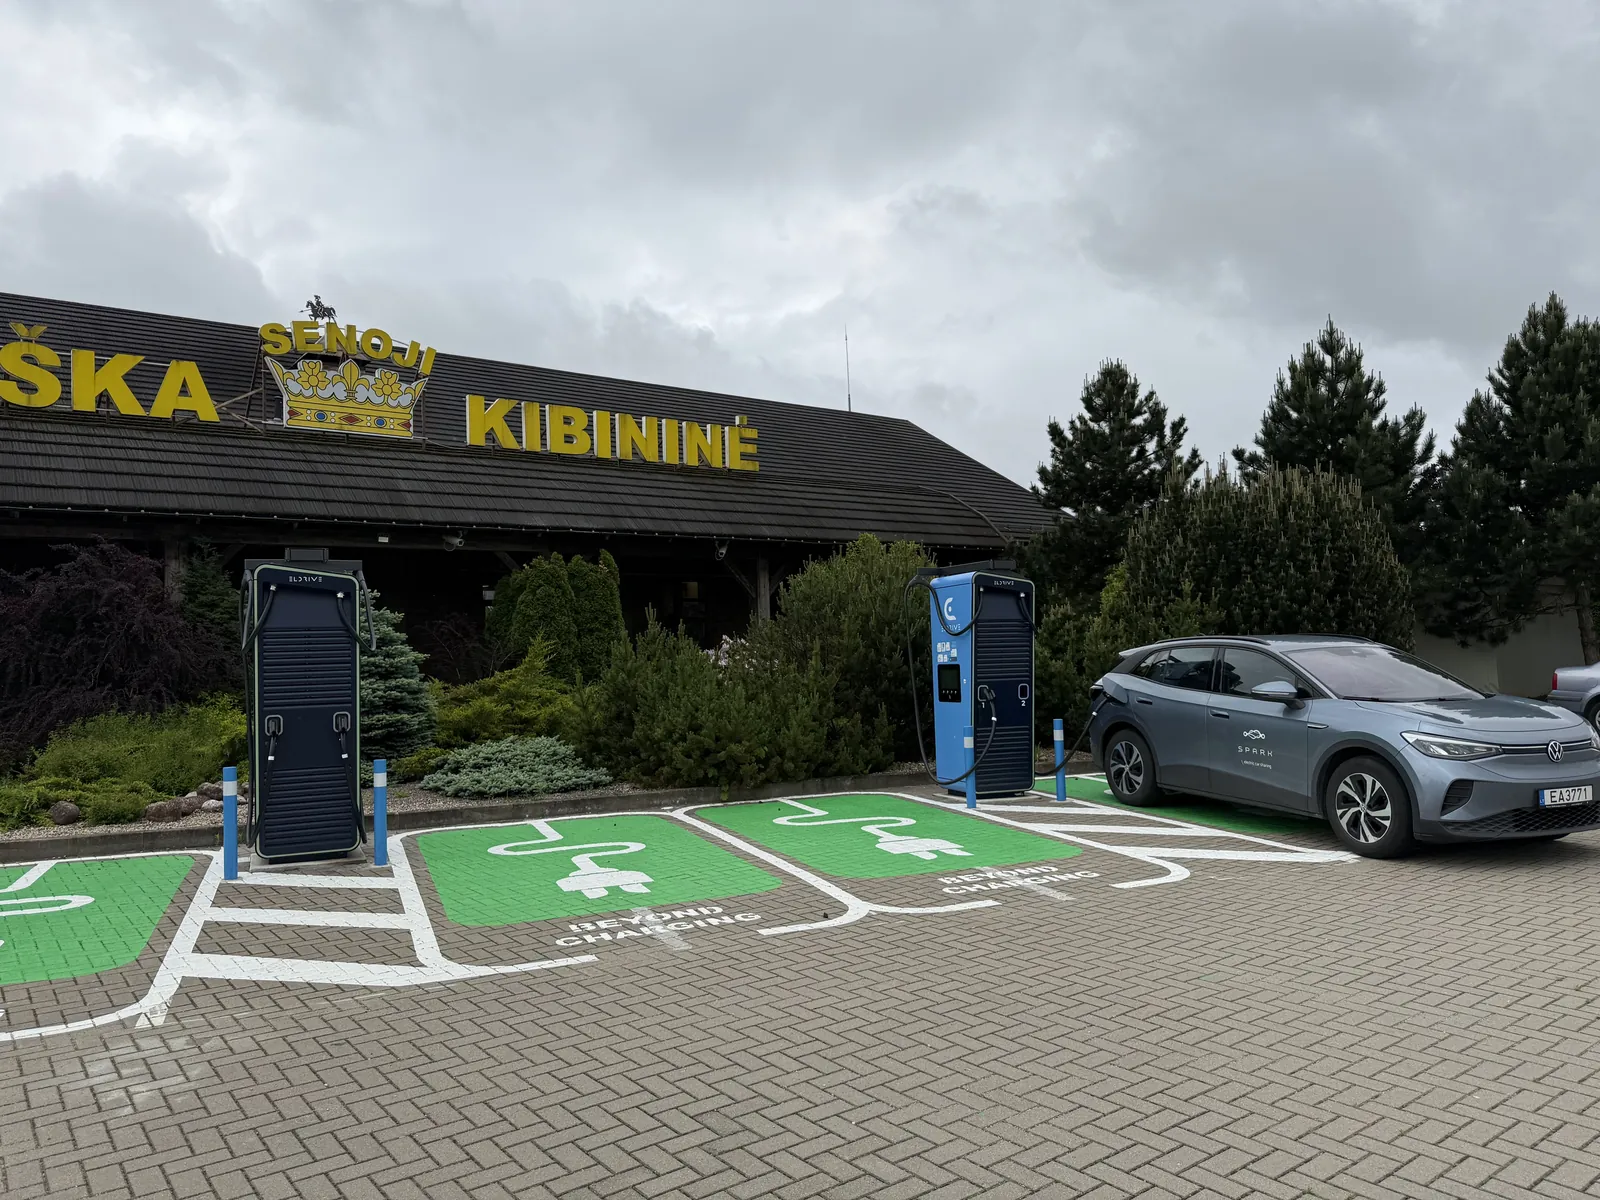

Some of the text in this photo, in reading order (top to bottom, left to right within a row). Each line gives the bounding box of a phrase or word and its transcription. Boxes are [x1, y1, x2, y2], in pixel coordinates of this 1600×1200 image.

[258, 320, 437, 376] SENOJI
[0, 322, 759, 472] ŠKA KIBININĖ
[1237, 745, 1273, 757] SPARK
[1550, 788, 1588, 803] EA3771
[938, 866, 1059, 884] BEYOND
[942, 871, 1100, 894] CHARGING
[555, 913, 761, 946] CHARGING
[568, 906, 723, 932] BEYOND
